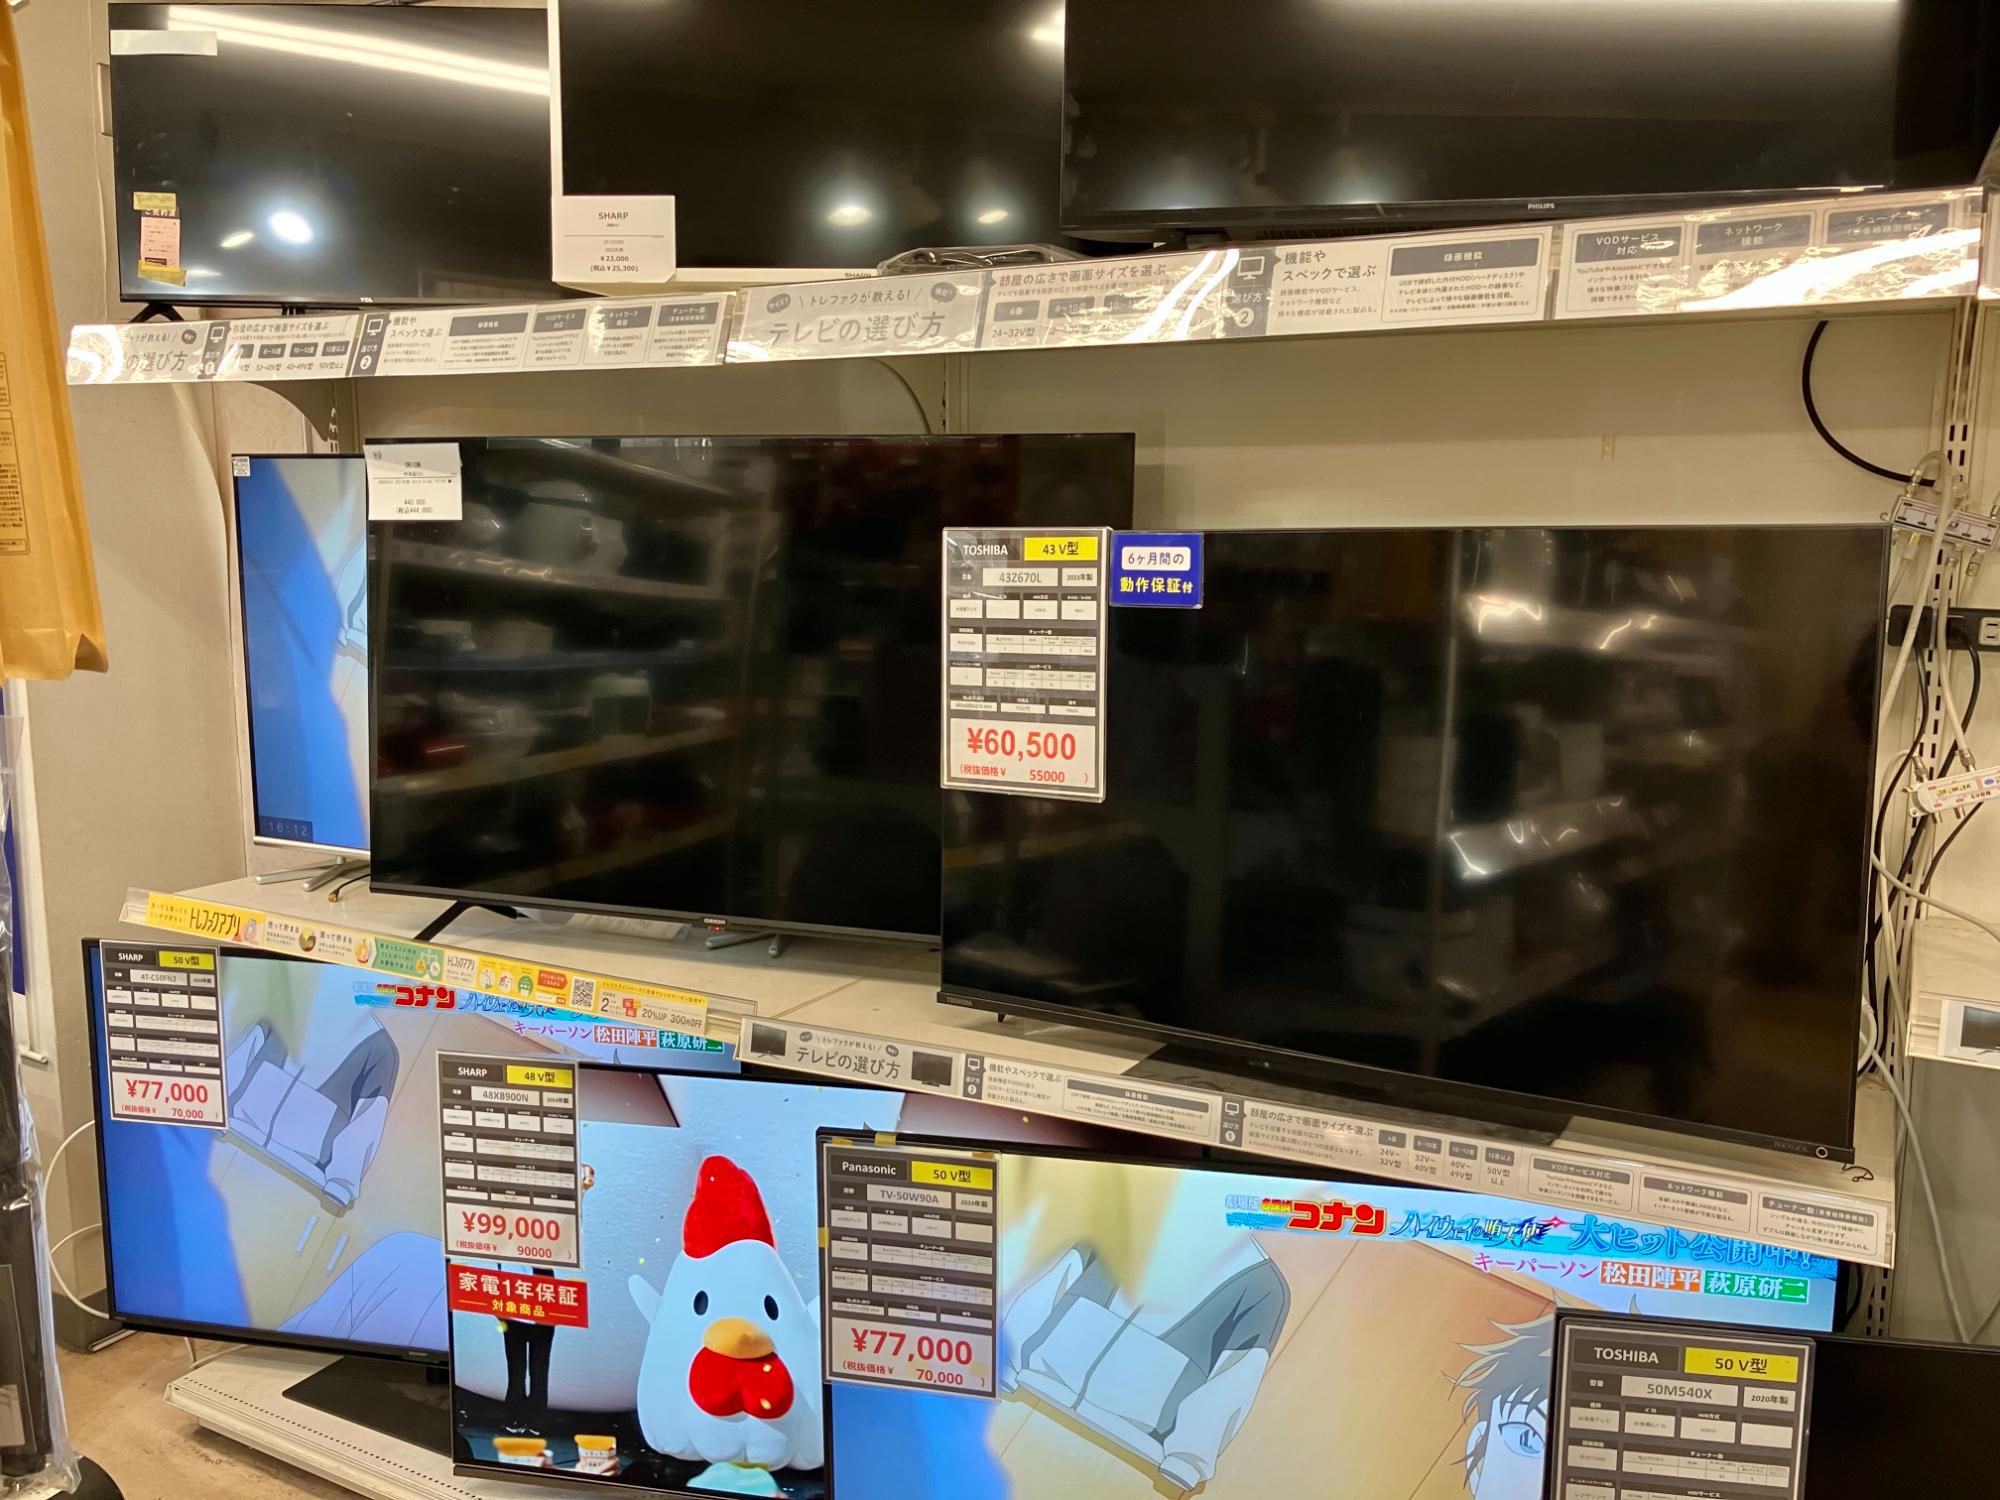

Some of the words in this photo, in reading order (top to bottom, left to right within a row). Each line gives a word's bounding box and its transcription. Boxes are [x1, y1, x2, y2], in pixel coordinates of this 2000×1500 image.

[1527, 202, 1555, 210] PHILIPS
[598, 212, 629, 220] SHARP
[1724, 223, 1783, 236] ネットワーク
[1596, 233, 1660, 246] VODサービス
[1284, 250, 1327, 265] 機能や
[1616, 246, 1638, 256] 対応
[999, 264, 1167, 287] 部屋の広さで画面サイズを選ぶ
[1283, 265, 1377, 282] スペックで選ぶ
[769, 311, 946, 345] テレビの選び方
[963, 544, 1009, 556] TOSHIBA
[1043, 544, 1056, 555] 43
[1058, 541, 1079, 556] V型
[999, 572, 1042, 584] 43Z670L
[1120, 577, 1194, 594] 動作保証付
[967, 727, 1077, 762] ¥60,500
[1029, 769, 1066, 783] 55000
[118, 952, 144, 961] SHARP
[174, 956, 184, 965] 50
[394, 984, 456, 1010] コナン
[600, 997, 610, 1013] 2
[514, 1020, 593, 1040] キーパーソン
[595, 1026, 657, 1047] 松田陣平
[458, 1066, 488, 1078] SHARP
[797, 1047, 901, 1080] テレビの選び方
[524, 1072, 536, 1081] 48
[538, 1071, 556, 1083] V型
[989, 1063, 1062, 1082] 機能やスペックで選ぶ
[126, 1079, 208, 1104] ¥77,000
[171, 1107, 204, 1119] 70,000
[1250, 1107, 1374, 1137] 部屋の広さで画面サイズを選ぶ
[842, 1161, 897, 1176] Panasonic
[933, 1169, 947, 1181] 50
[950, 1169, 971, 1184] V型
[1487, 1167, 1511, 1177] 50V型
[1551, 1162, 1611, 1180] VODサービス対応
[880, 1189, 939, 1205] TV-50W90A
[1667, 1182, 1724, 1199] ネットワーク機能
[461, 1210, 561, 1241] ¥99,000
[1288, 1200, 1387, 1236] コナン
[1568, 1214, 1811, 1269] 大ヒット公開中!
[517, 1245, 553, 1259] 90000
[1474, 1252, 1599, 1279] キーパーソン
[458, 1272, 579, 1307] 家電1年保証
[1603, 1262, 1700, 1291] 松田陣平
[1706, 1271, 1806, 1301] 萩原研二
[492, 1299, 545, 1318] 対象商品
[851, 1327, 973, 1366] ¥77,000
[1594, 1347, 1659, 1364] TOSHIBA
[1715, 1358, 1734, 1370] 50
[1738, 1358, 1768, 1374] V型
[916, 1368, 964, 1386] 70,000
[1647, 1383, 1713, 1400] 50M540X
